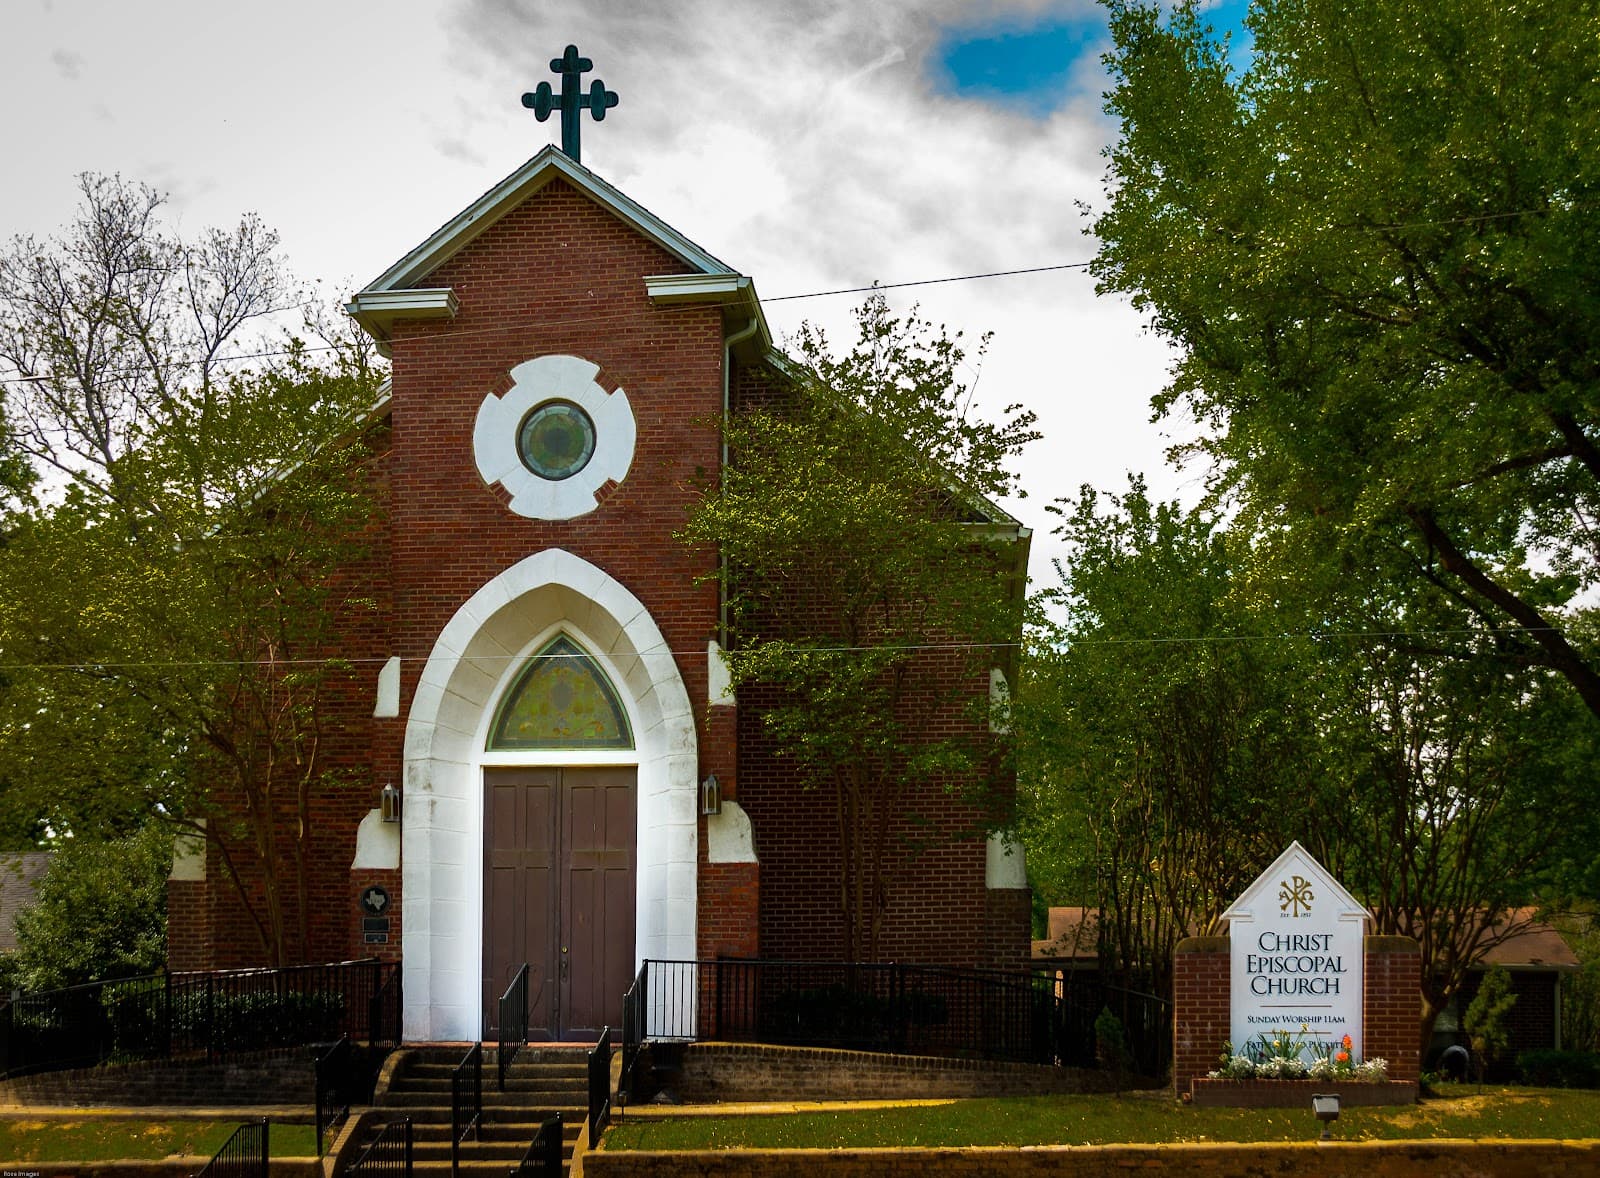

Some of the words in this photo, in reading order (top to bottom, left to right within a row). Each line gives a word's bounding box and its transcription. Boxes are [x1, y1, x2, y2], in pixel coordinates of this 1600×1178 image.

[1258, 931, 1334, 952] CHRIST
[1247, 954, 1347, 973] EPISCOPAL
[1250, 975, 1340, 995] CHURCH
[1247, 1015, 1281, 1024] SUNDAY
[1282, 1015, 1322, 1024] WORSHIP
[1324, 1015, 1345, 1024] 11AM
